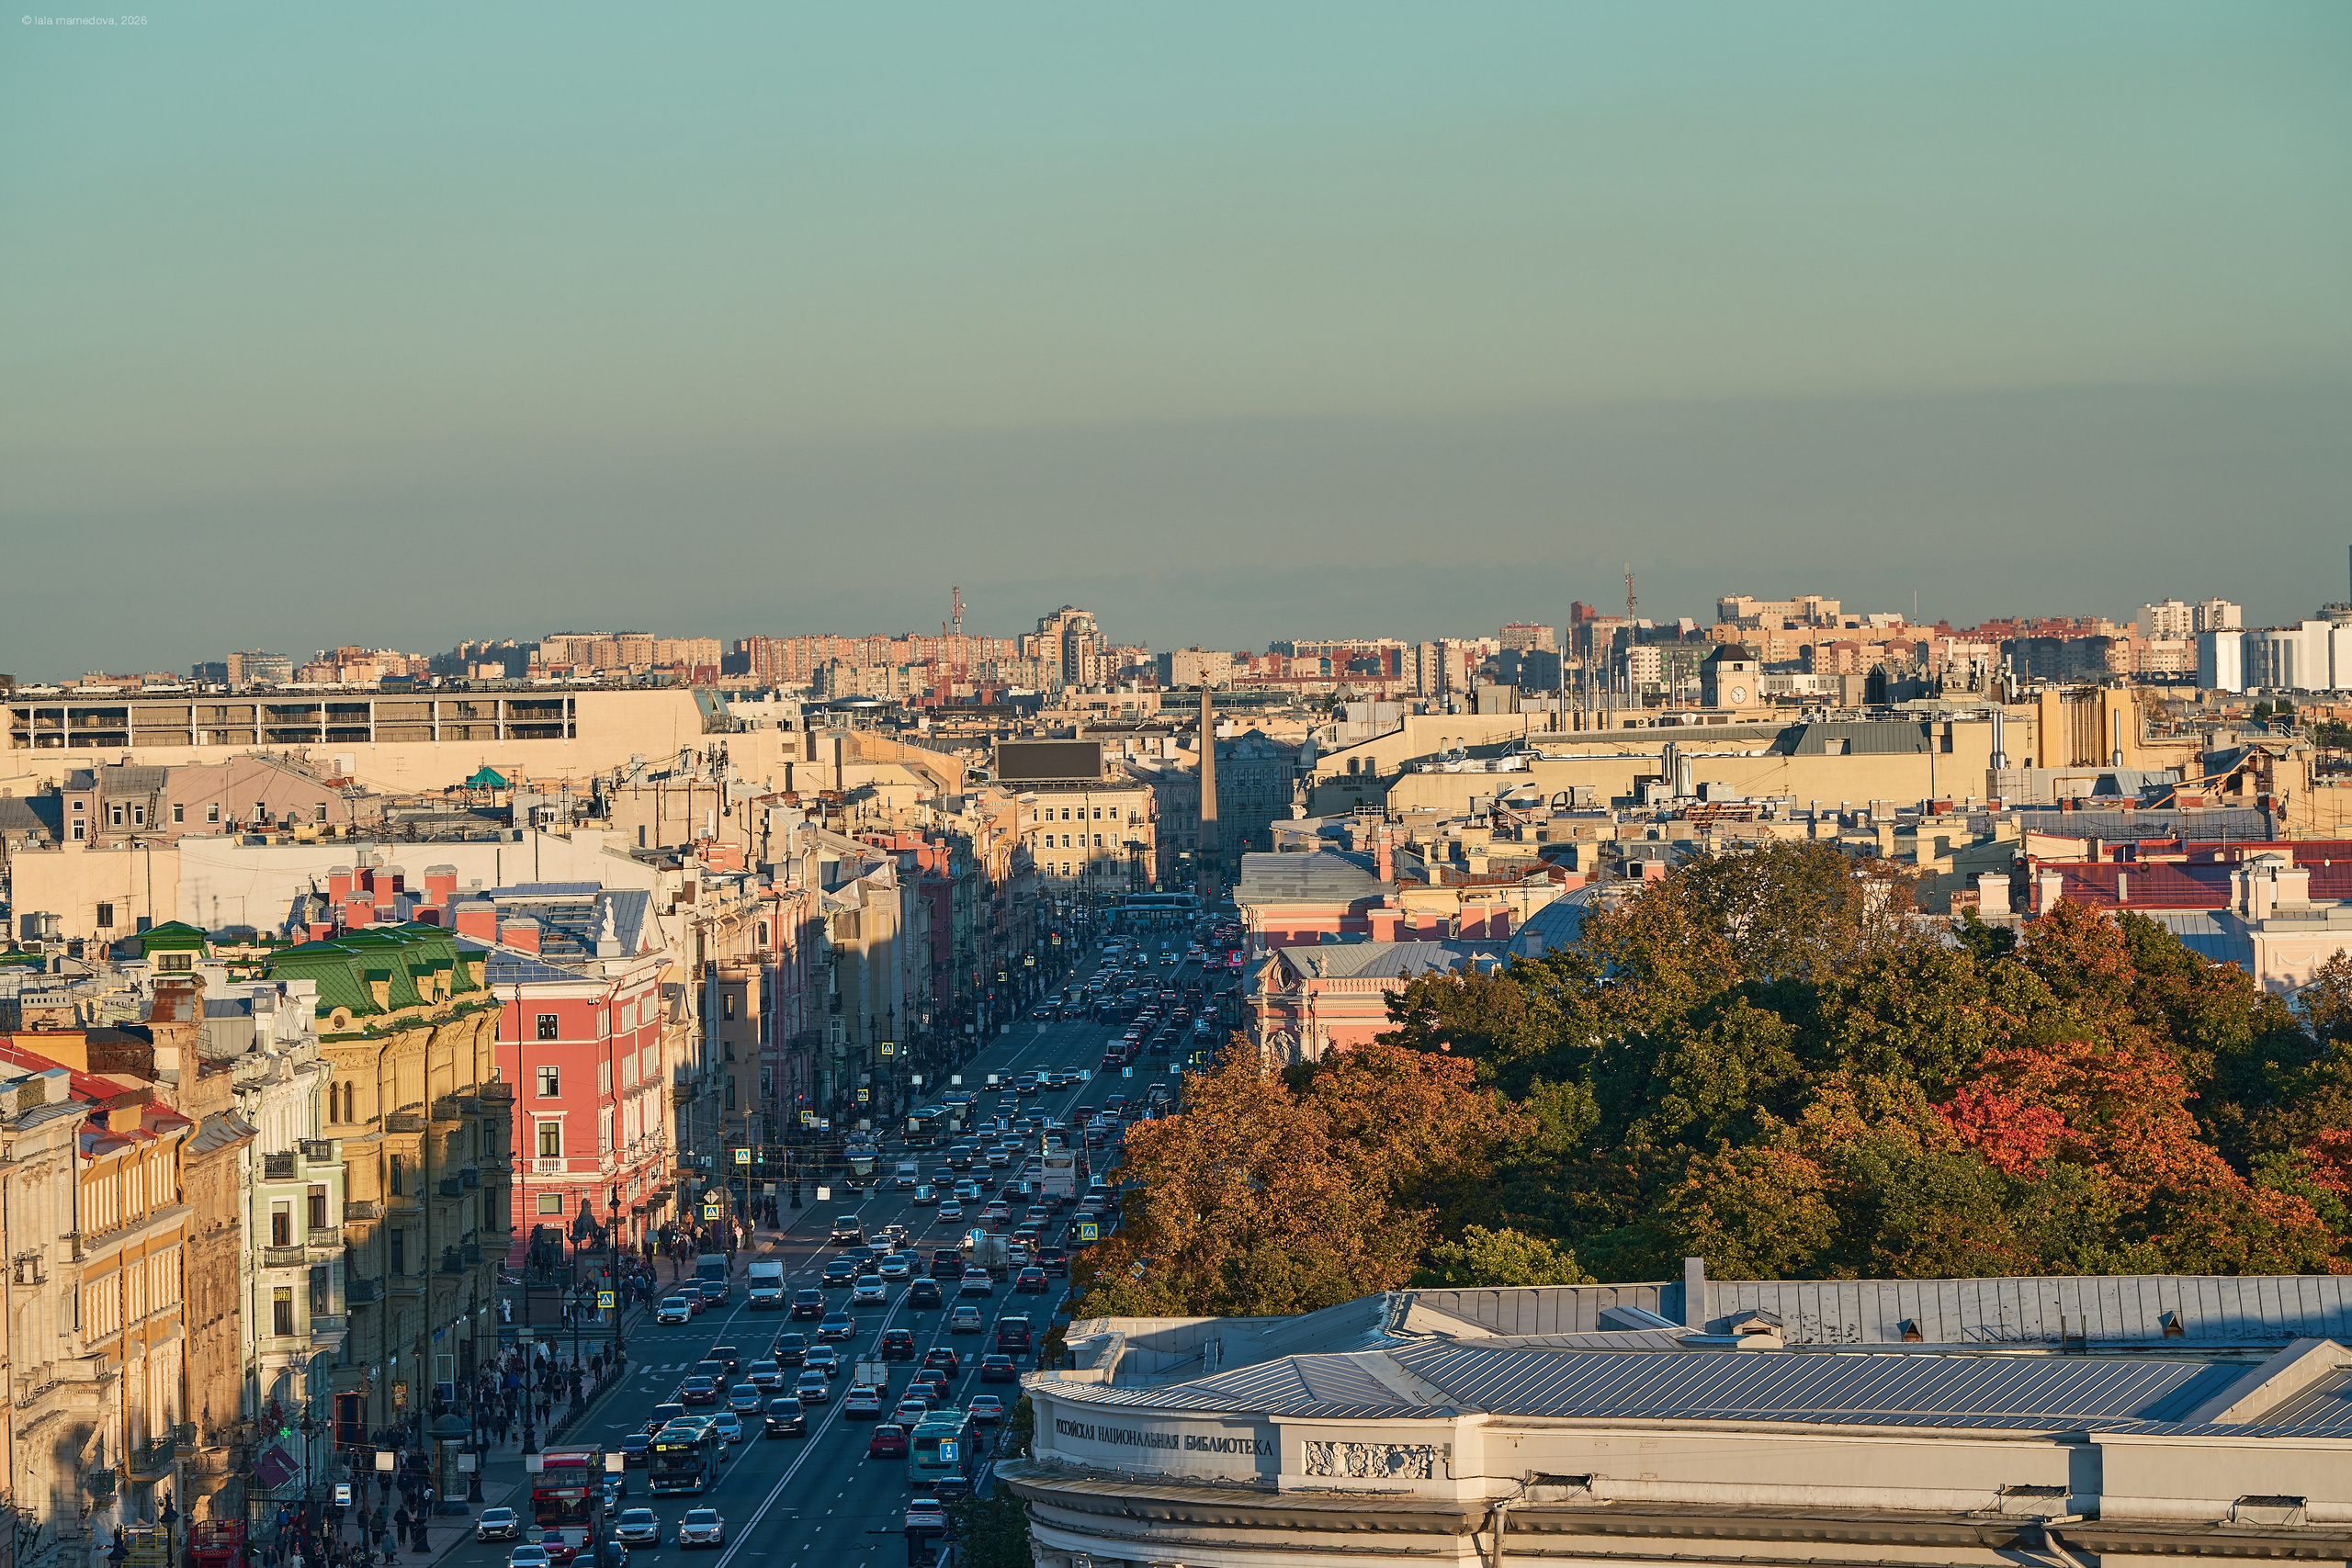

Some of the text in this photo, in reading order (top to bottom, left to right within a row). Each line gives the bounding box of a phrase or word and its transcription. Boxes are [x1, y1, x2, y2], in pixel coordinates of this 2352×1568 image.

[1317, 775, 1386, 785] CORINTHIA
[1056, 1418, 1273, 1456] РОССИЙСКАЯ НАЦИОНАЛЬНАЯ БИБЛИОТЕКА
